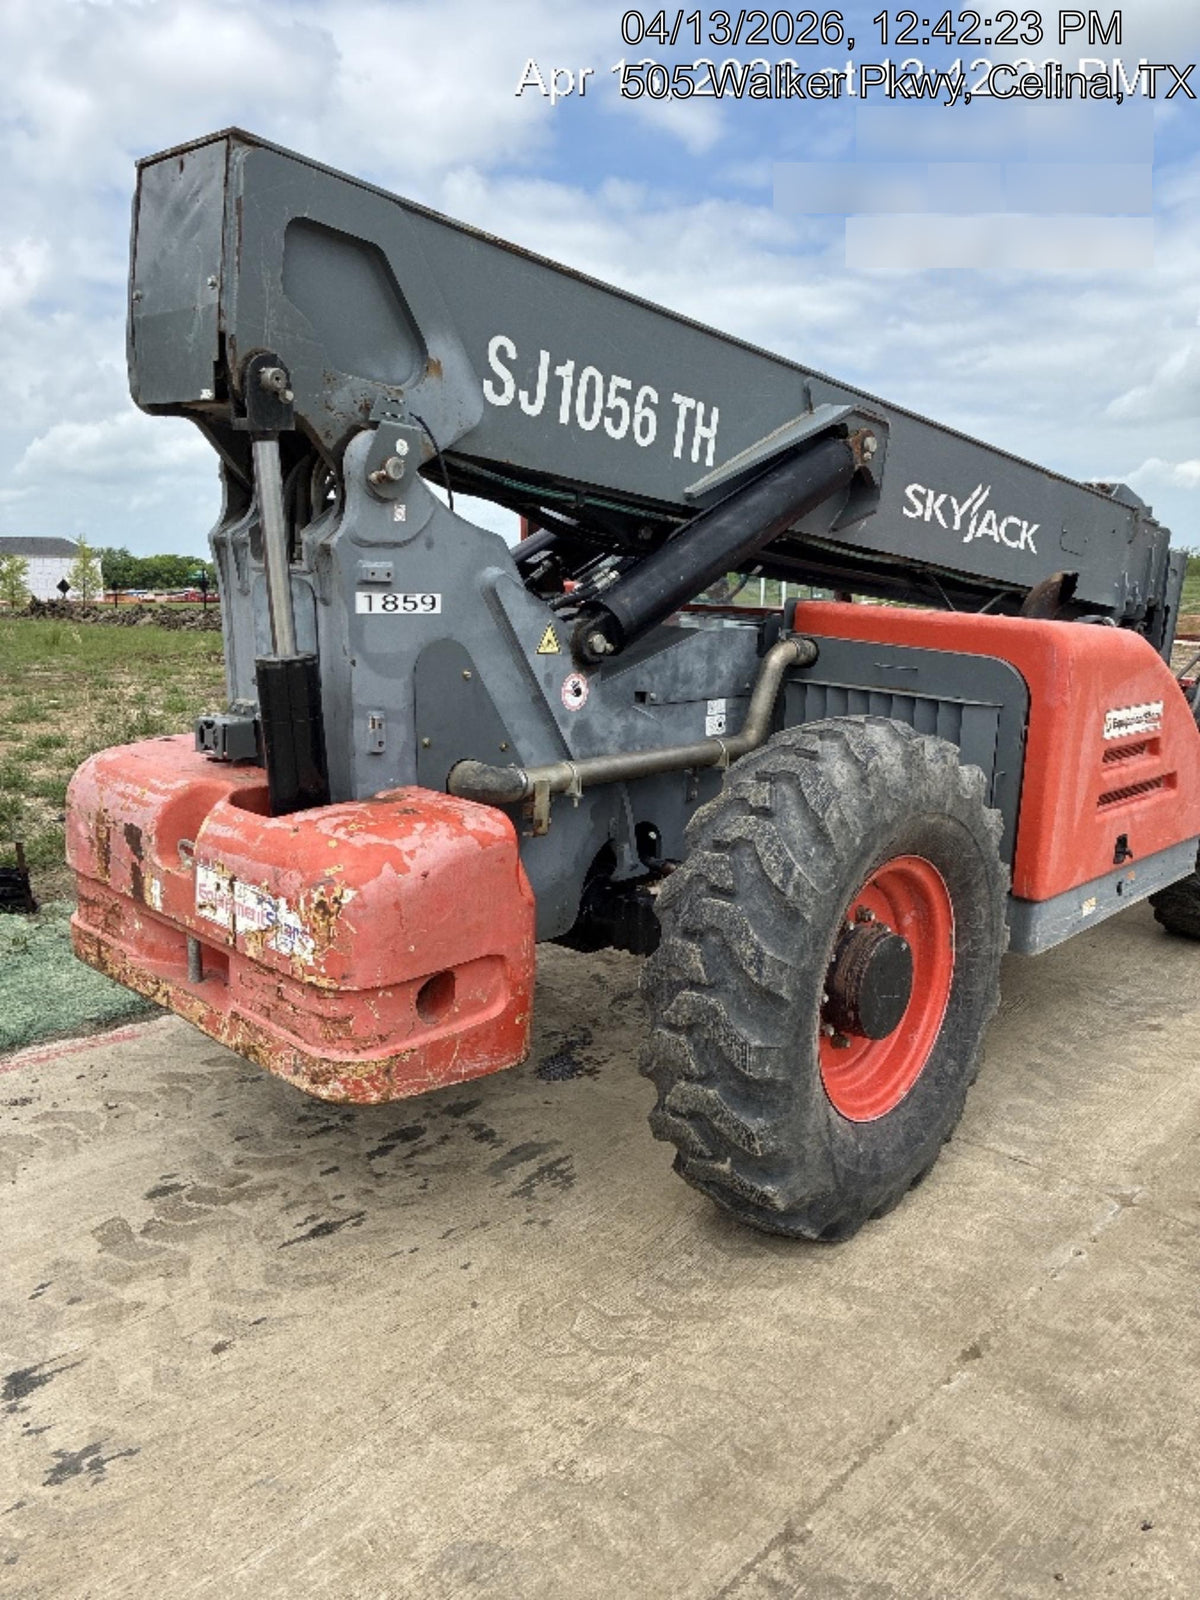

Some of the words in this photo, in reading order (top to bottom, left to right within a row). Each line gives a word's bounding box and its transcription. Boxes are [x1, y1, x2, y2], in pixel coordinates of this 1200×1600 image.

[483, 335, 659, 447] SJ1056
[671, 392, 719, 467] TH
[902, 483, 1041, 555] SKYJACK
[363, 593, 437, 612] 1859
